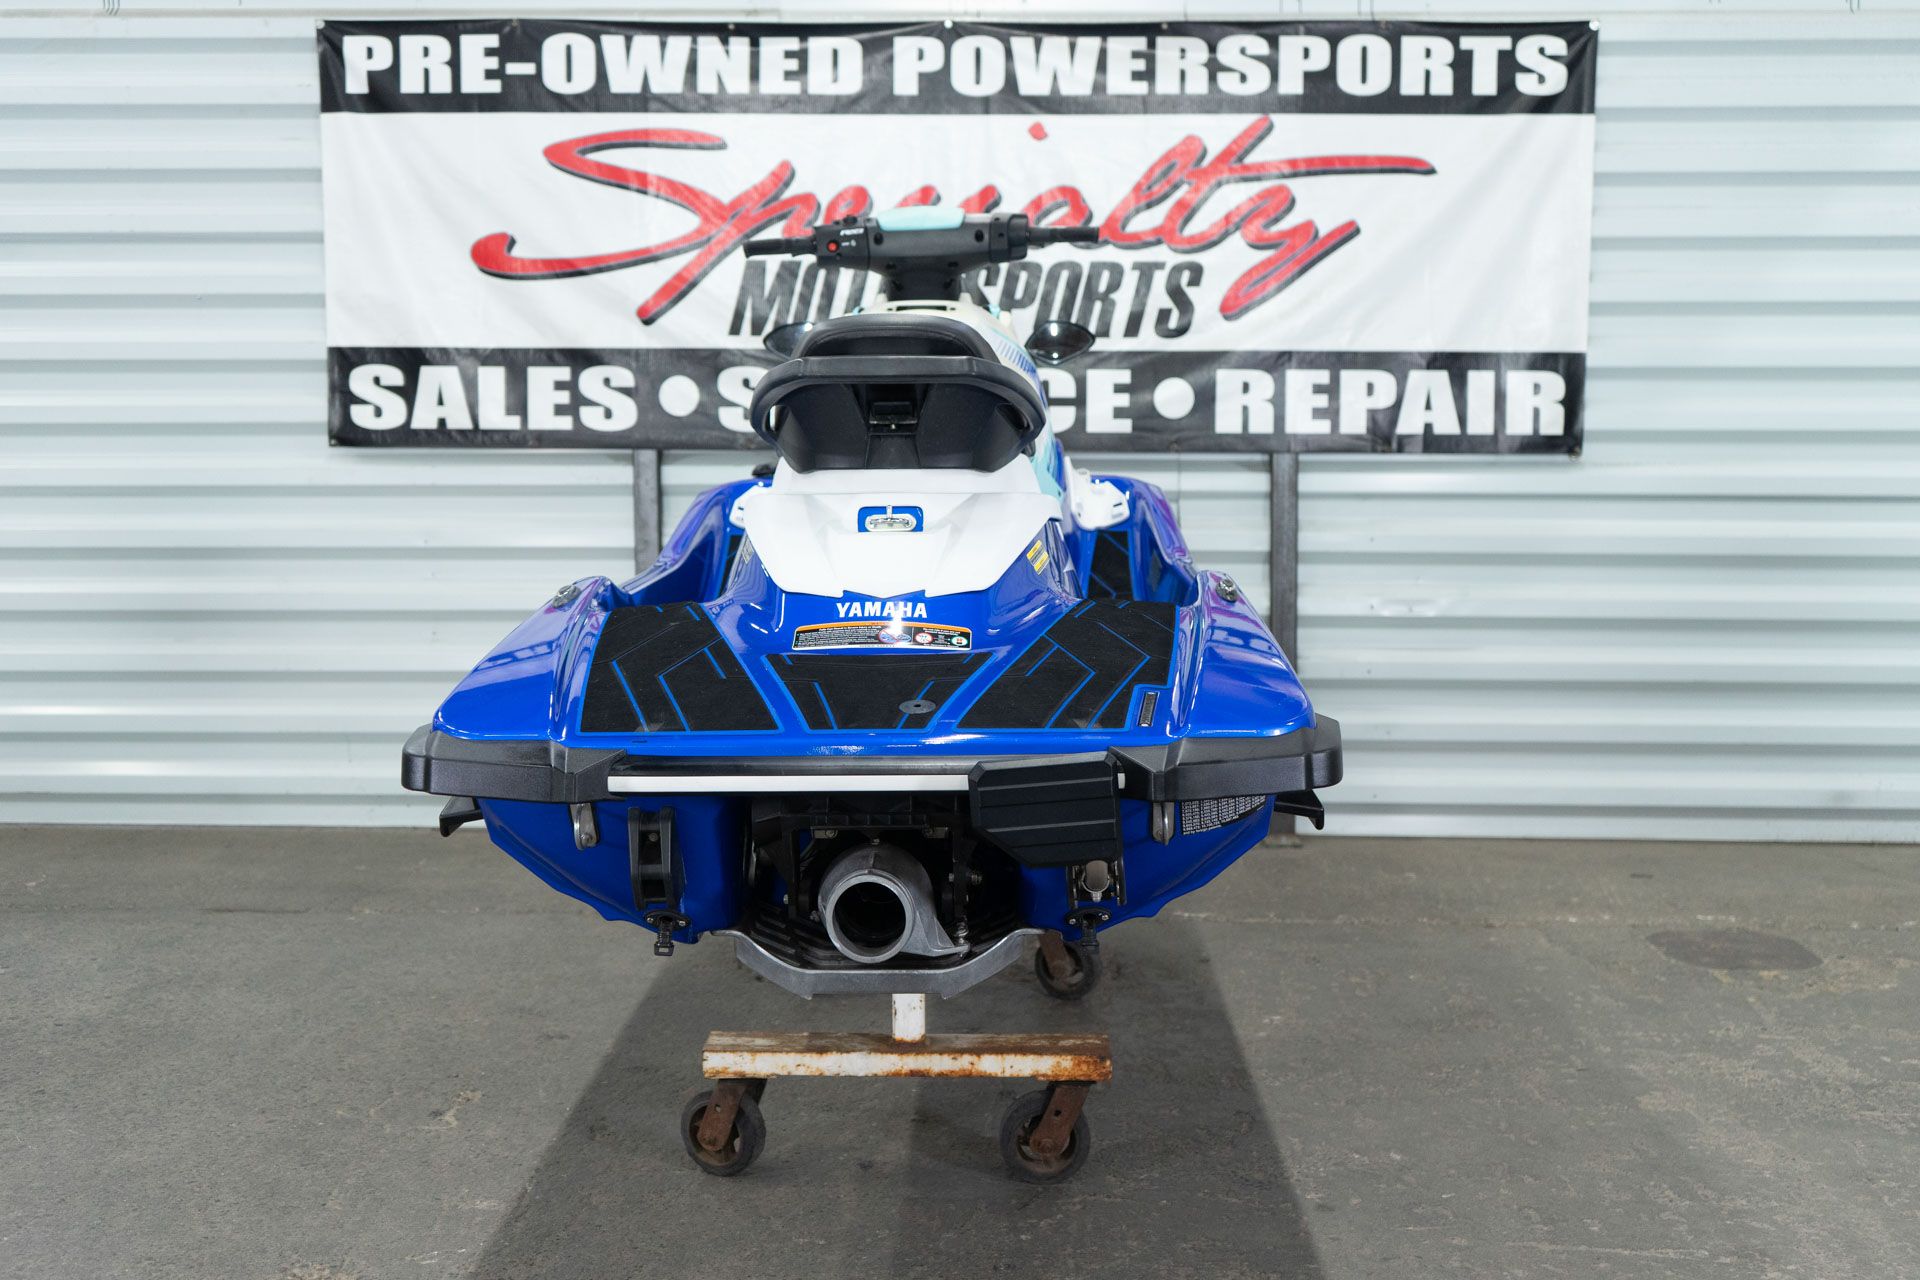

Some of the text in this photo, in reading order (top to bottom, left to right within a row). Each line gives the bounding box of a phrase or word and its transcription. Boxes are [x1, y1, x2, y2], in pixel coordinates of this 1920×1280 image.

[342, 32, 1569, 97] PRE-OWNED POWERSPORTS
[470, 115, 1437, 326] Speialty
[728, 260, 1204, 338] MOSPORTS
[348, 363, 639, 433] SALES
[1214, 368, 1567, 436] REPAIR
[836, 602, 928, 618] YAMAHA
